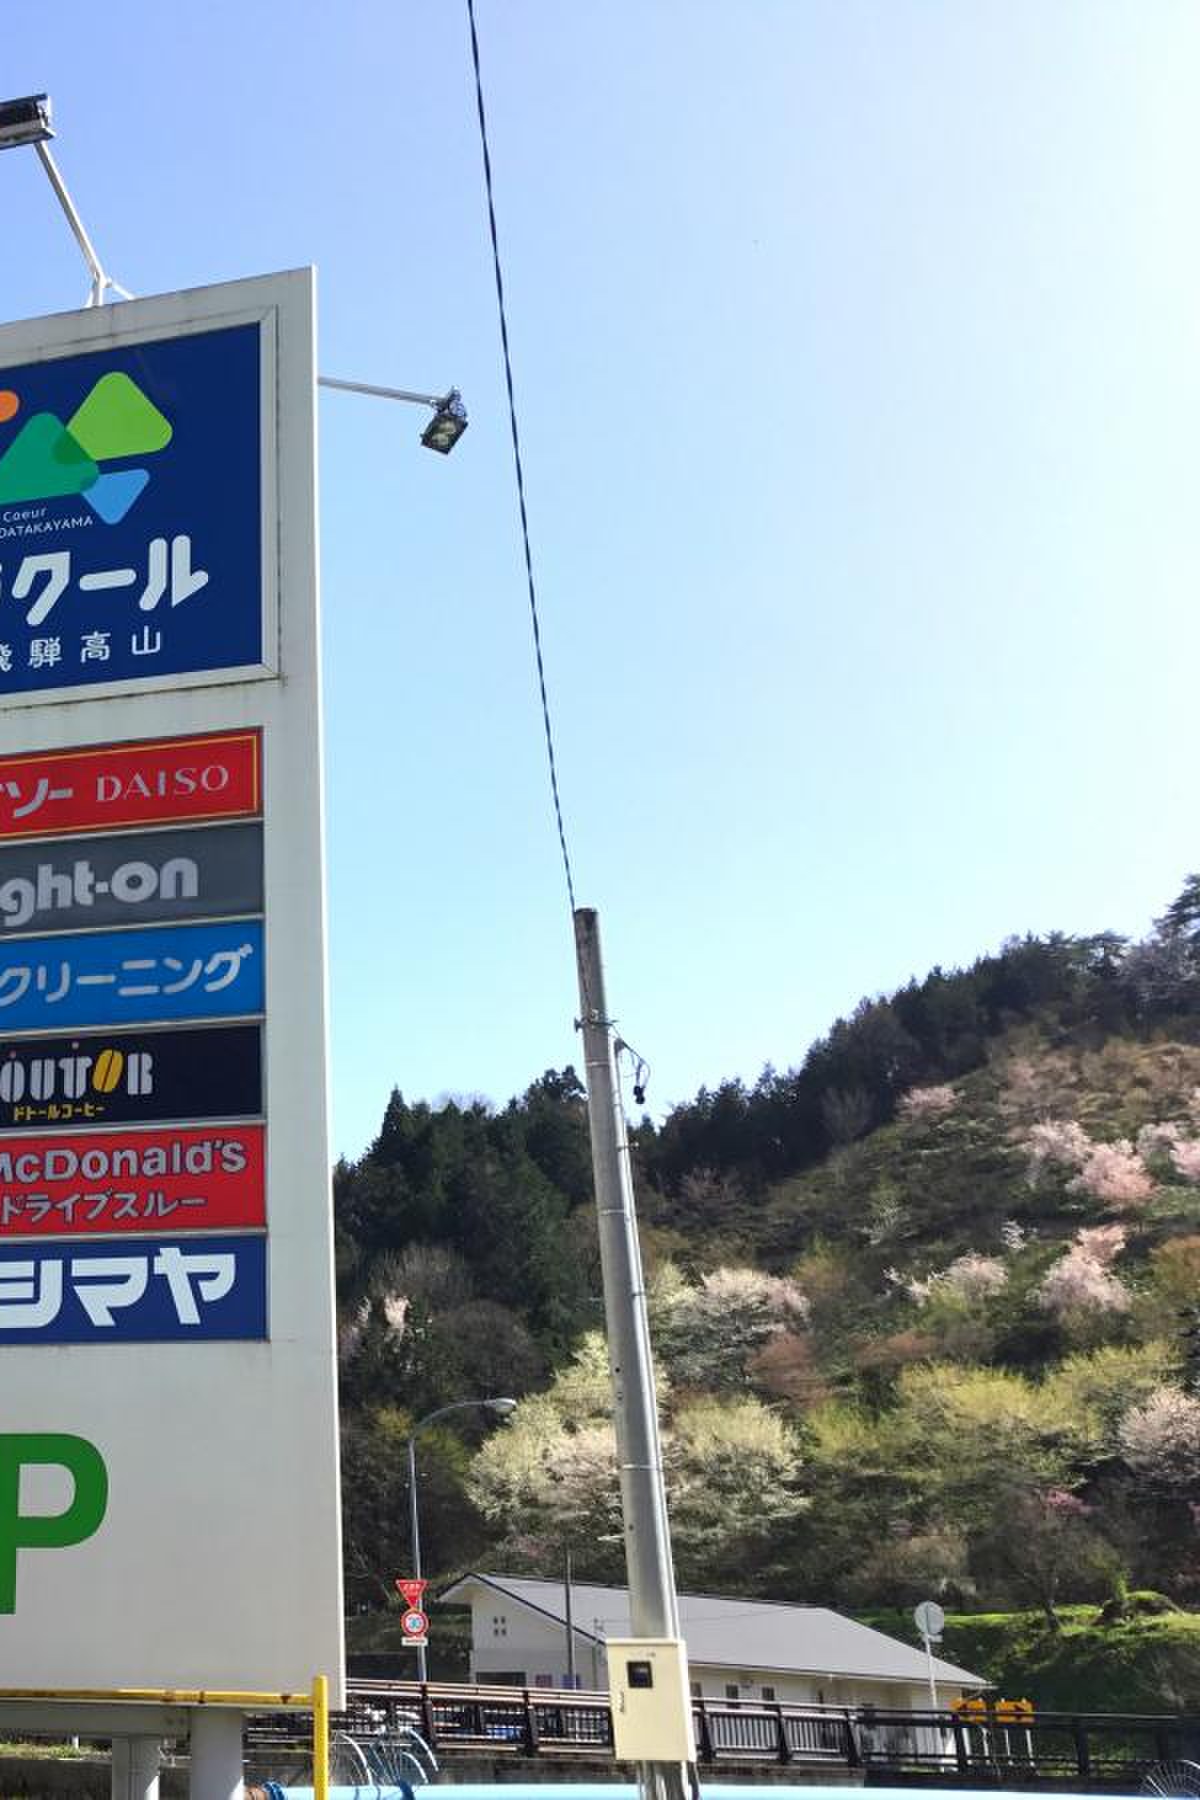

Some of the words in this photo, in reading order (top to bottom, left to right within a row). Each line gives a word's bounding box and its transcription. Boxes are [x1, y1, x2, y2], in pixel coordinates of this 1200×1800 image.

[3, 507, 47, 523] Coeur
[96, 766, 229, 802] DAISO
[13, 1101, 105, 1121] ドトールコーヒー
[1, 1190, 206, 1226] ドライブスルー
